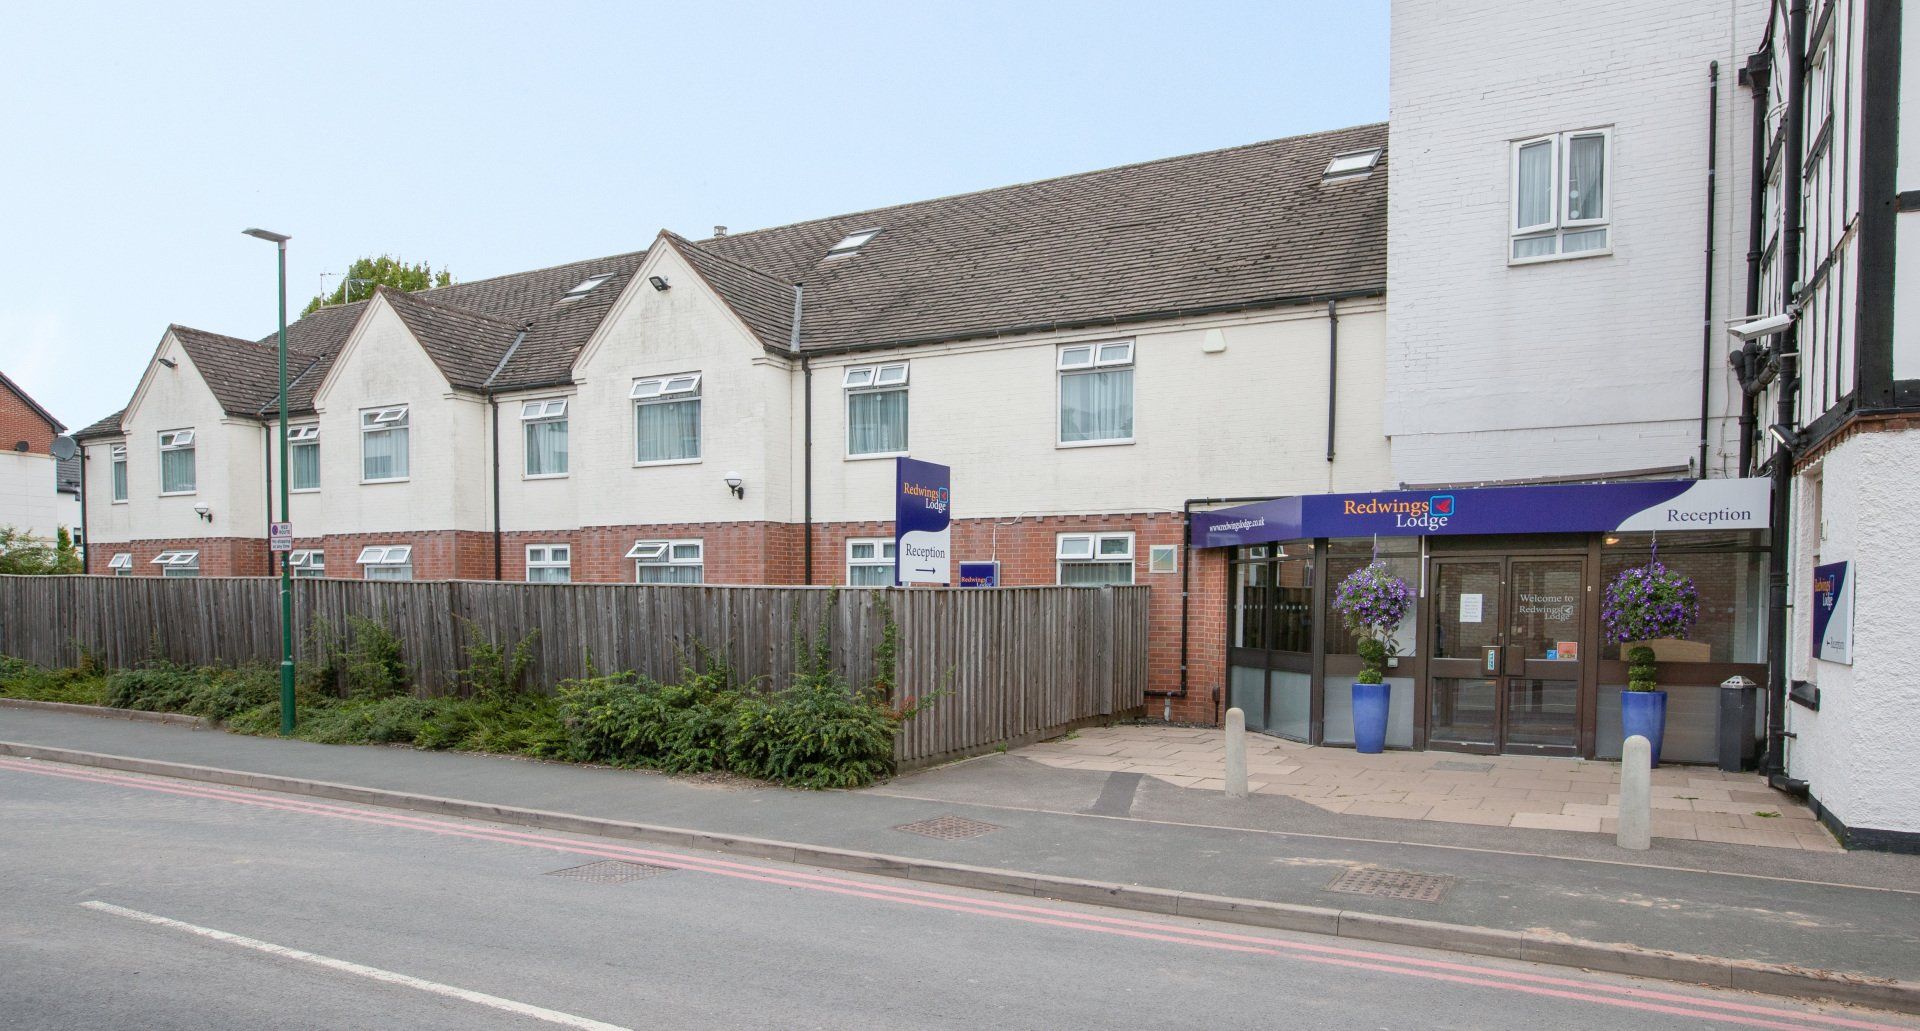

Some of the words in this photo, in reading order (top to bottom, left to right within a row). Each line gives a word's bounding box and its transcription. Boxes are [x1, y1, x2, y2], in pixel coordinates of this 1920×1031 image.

[903, 482, 939, 501] Redwings
[925, 498, 947, 513] Lodge
[1343, 498, 1430, 517] Redwings
[1396, 513, 1448, 531] Lodge
[1667, 507, 1751, 524] Reception
[1209, 516, 1265, 532] www.redwingslodge.co.uk
[905, 543, 945, 561] Reception
[1520, 593, 1562, 602] Welcome
[1519, 605, 1561, 615] Redwings
[1544, 612, 1570, 621] Lodge
